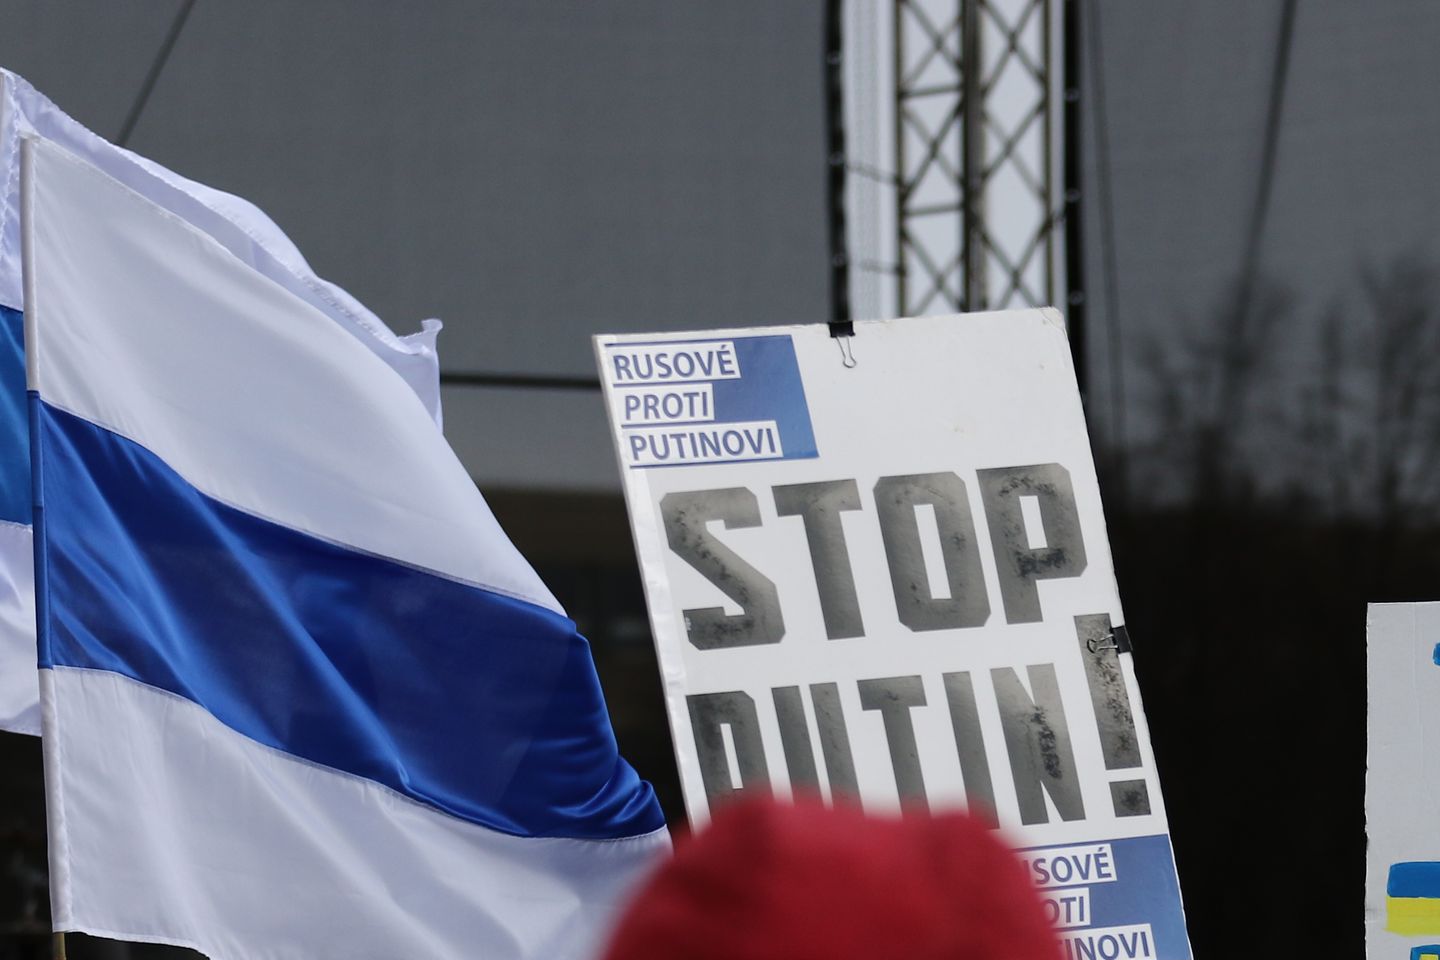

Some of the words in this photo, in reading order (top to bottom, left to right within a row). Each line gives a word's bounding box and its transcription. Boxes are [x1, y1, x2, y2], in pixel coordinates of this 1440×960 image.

[613, 344, 736, 380] RUSOVÉ
[625, 391, 708, 420] PROTI
[629, 427, 777, 461] PUTINOVI
[660, 463, 1087, 650] STOP
[1024, 847, 1112, 885] SOVÉ
[1042, 896, 1084, 924] OTI
